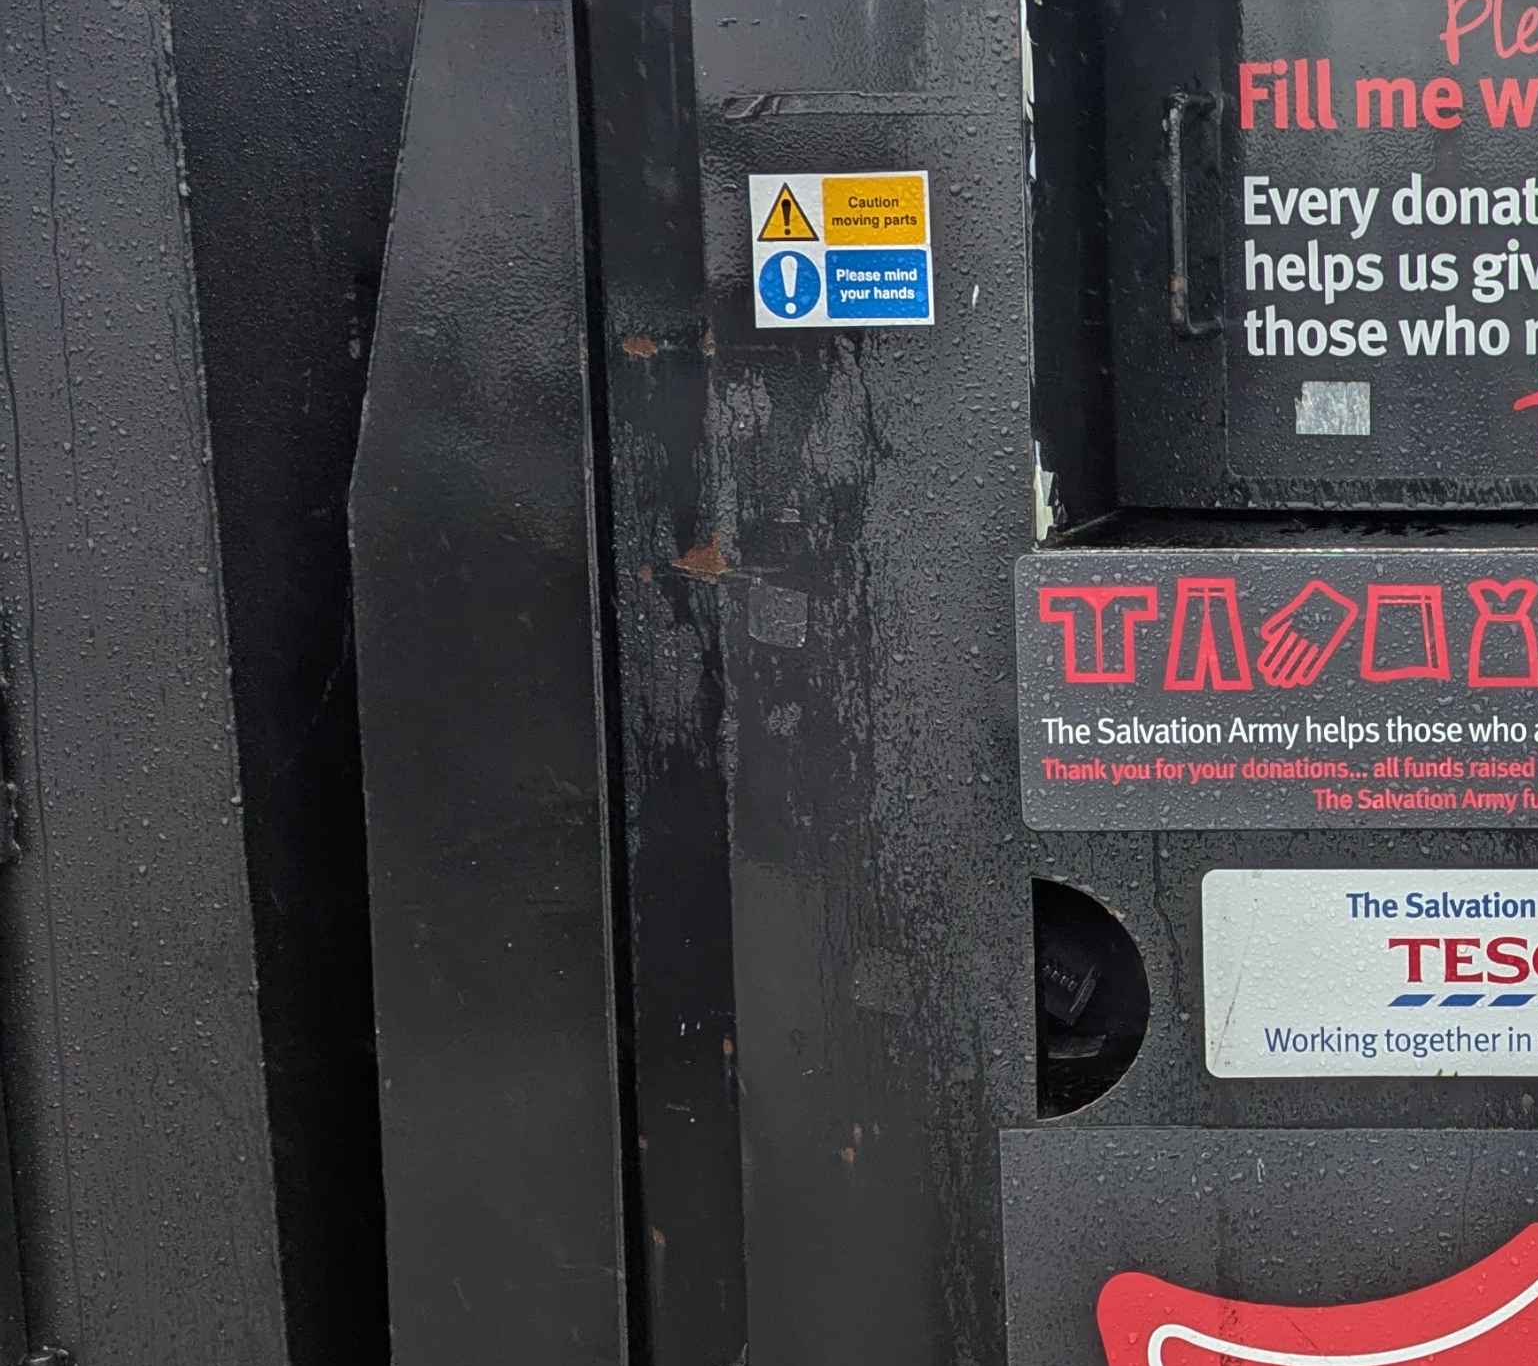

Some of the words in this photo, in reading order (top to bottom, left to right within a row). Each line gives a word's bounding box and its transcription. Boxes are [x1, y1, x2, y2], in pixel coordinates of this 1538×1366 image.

[1239, 58, 1337, 130] Fill
[1354, 75, 1465, 131] me
[847, 195, 900, 209] Caution
[1243, 175, 1380, 240] Every
[831, 213, 880, 229] moving
[883, 214, 918, 229] parts
[835, 268, 882, 283] Please
[883, 268, 918, 282] mind
[1244, 239, 1384, 305] helps
[1398, 252, 1460, 292] us
[839, 289, 872, 303] your
[873, 286, 916, 300] hands
[1243, 305, 1389, 357] those
[1398, 305, 1512, 356] who
[1041, 716, 1091, 745] The
[1097, 716, 1222, 745] Salvation
[1227, 716, 1300, 751] Army
[1305, 715, 1380, 750] helps
[1385, 715, 1463, 743] those
[1468, 715, 1527, 743] who
[1041, 757, 1108, 780] Thank
[1110, 763, 1152, 785] you
[1154, 757, 1185, 780] for
[1187, 762, 1237, 784] your
[1240, 758, 1367, 780] donations...
[1373, 756, 1401, 780] all
[1402, 755, 1464, 780] funds
[1468, 758, 1537, 780] raised
[1313, 787, 1353, 810] The
[1357, 787, 1457, 811] Salvation
[1459, 788, 1518, 812] Army
[1345, 891, 1399, 919] The
[1405, 891, 1536, 919] Salvation
[1264, 1026, 1379, 1059] Working
[1383, 1025, 1502, 1058] together
[1508, 1026, 1532, 1052] in
